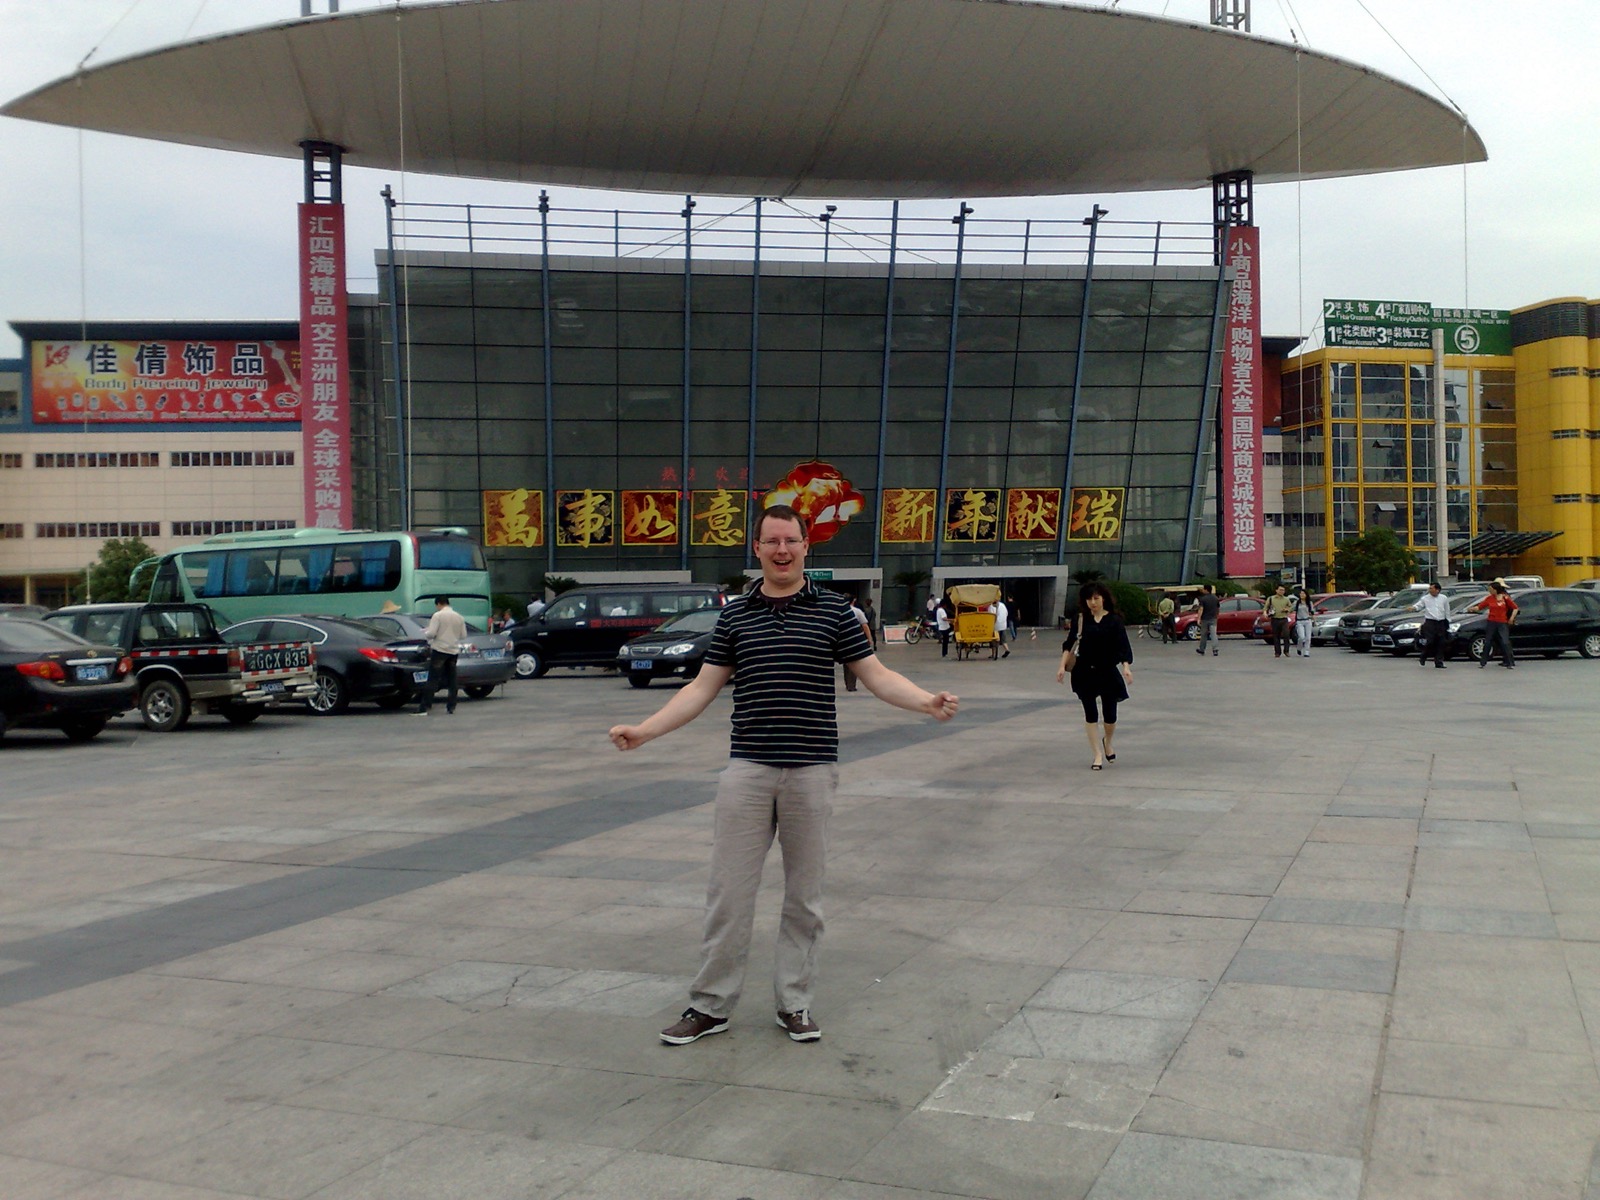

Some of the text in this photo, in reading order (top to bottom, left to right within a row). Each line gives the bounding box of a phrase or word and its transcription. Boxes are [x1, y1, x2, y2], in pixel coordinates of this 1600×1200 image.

[308, 216, 336, 316] 汇四海精品
[1325, 302, 1336, 318] 2
[1344, 302, 1369, 313] 头饰
[1375, 303, 1386, 319] 4
[1392, 303, 1430, 315] 厂家直销中心
[1328, 326, 1336, 342] 1
[1377, 327, 1387, 343] 3
[1393, 327, 1429, 339] 装饰工艺
[1460, 330, 1475, 349] 5
[85, 343, 264, 375] 佳倩饰品
[311, 322, 338, 422] 交五洲朋友
[85, 378, 127, 391] Body
[132, 378, 199, 391] Piercing
[204, 377, 268, 391] jewelry
[1230, 238, 1256, 552] 小商品海洋 购物者天堂 国际商贸城欢迎您
[285, 651, 307, 667] 835
